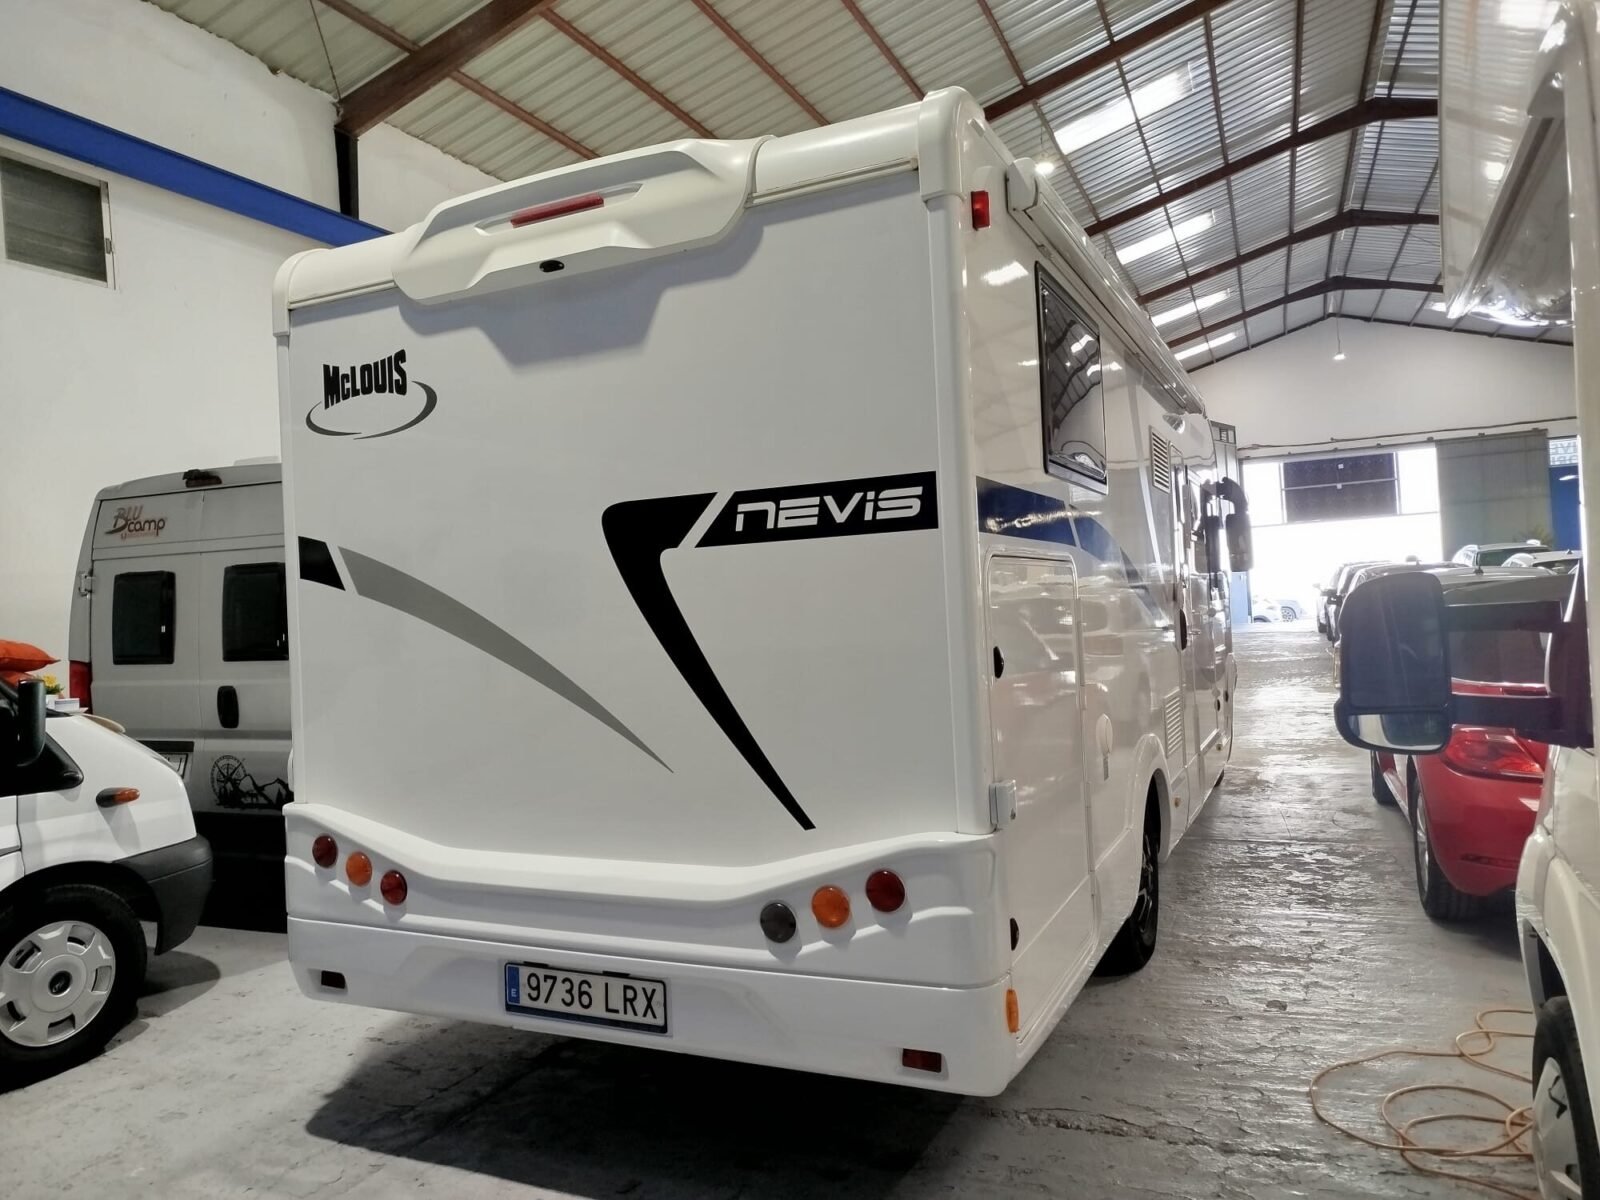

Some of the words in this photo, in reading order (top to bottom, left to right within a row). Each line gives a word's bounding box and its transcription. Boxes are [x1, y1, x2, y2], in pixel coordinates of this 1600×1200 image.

[322, 348, 408, 410] McLOUIS
[127, 517, 166, 536] camp
[526, 972, 593, 1010] 9736
[604, 982, 658, 1020] LRX
